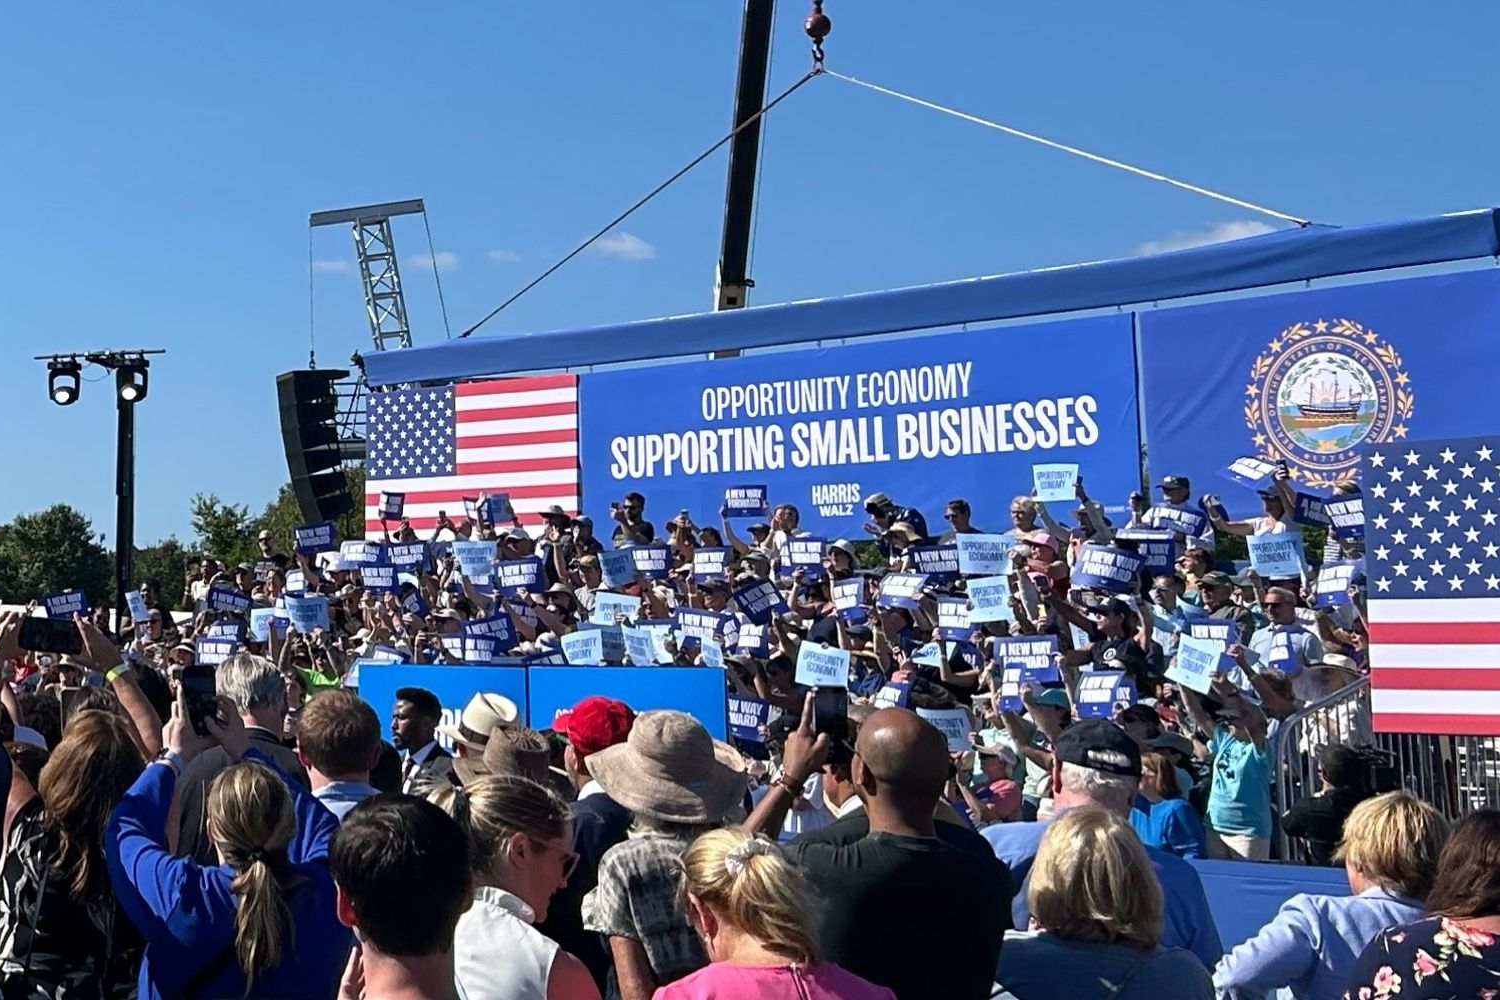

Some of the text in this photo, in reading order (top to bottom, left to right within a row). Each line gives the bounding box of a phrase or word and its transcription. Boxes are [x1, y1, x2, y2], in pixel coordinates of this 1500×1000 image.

[1327, 342, 1343, 351] OF
[1285, 343, 1317, 367] STATE
[1352, 350, 1377, 373] NEW
[702, 362, 972, 421] OPPORTUNITY ECONOMY
[1269, 374, 1283, 395] THE
[1268, 402, 1277, 417] OF
[610, 395, 1099, 479] SUPPORTING SMALL BUSINESSES
[1312, 453, 1345, 462] 1776
[725, 489, 762, 499] A NEW WAY
[812, 483, 861, 505] HARRIS
[728, 499, 761, 509] FORWARD
[819, 504, 854, 517] WALZ
[962, 541, 1009, 551] OPPORTUNITY
[914, 552, 921, 563] A
[921, 551, 939, 562] NEW
[969, 551, 1004, 561] ECONOMY
[1082, 550, 1089, 561] A
[1089, 551, 1116, 567] NEW
[1115, 554, 1140, 572] WAY
[919, 560, 958, 573] FORWARD
[1082, 561, 1133, 583] FORWARD
[999, 641, 1051, 656] A NEW WAY
[803, 651, 845, 667] OPPORTUNITY
[806, 662, 838, 677] ECONOMY
[740, 700, 763, 716] WAY
[729, 710, 757, 728] WARD
